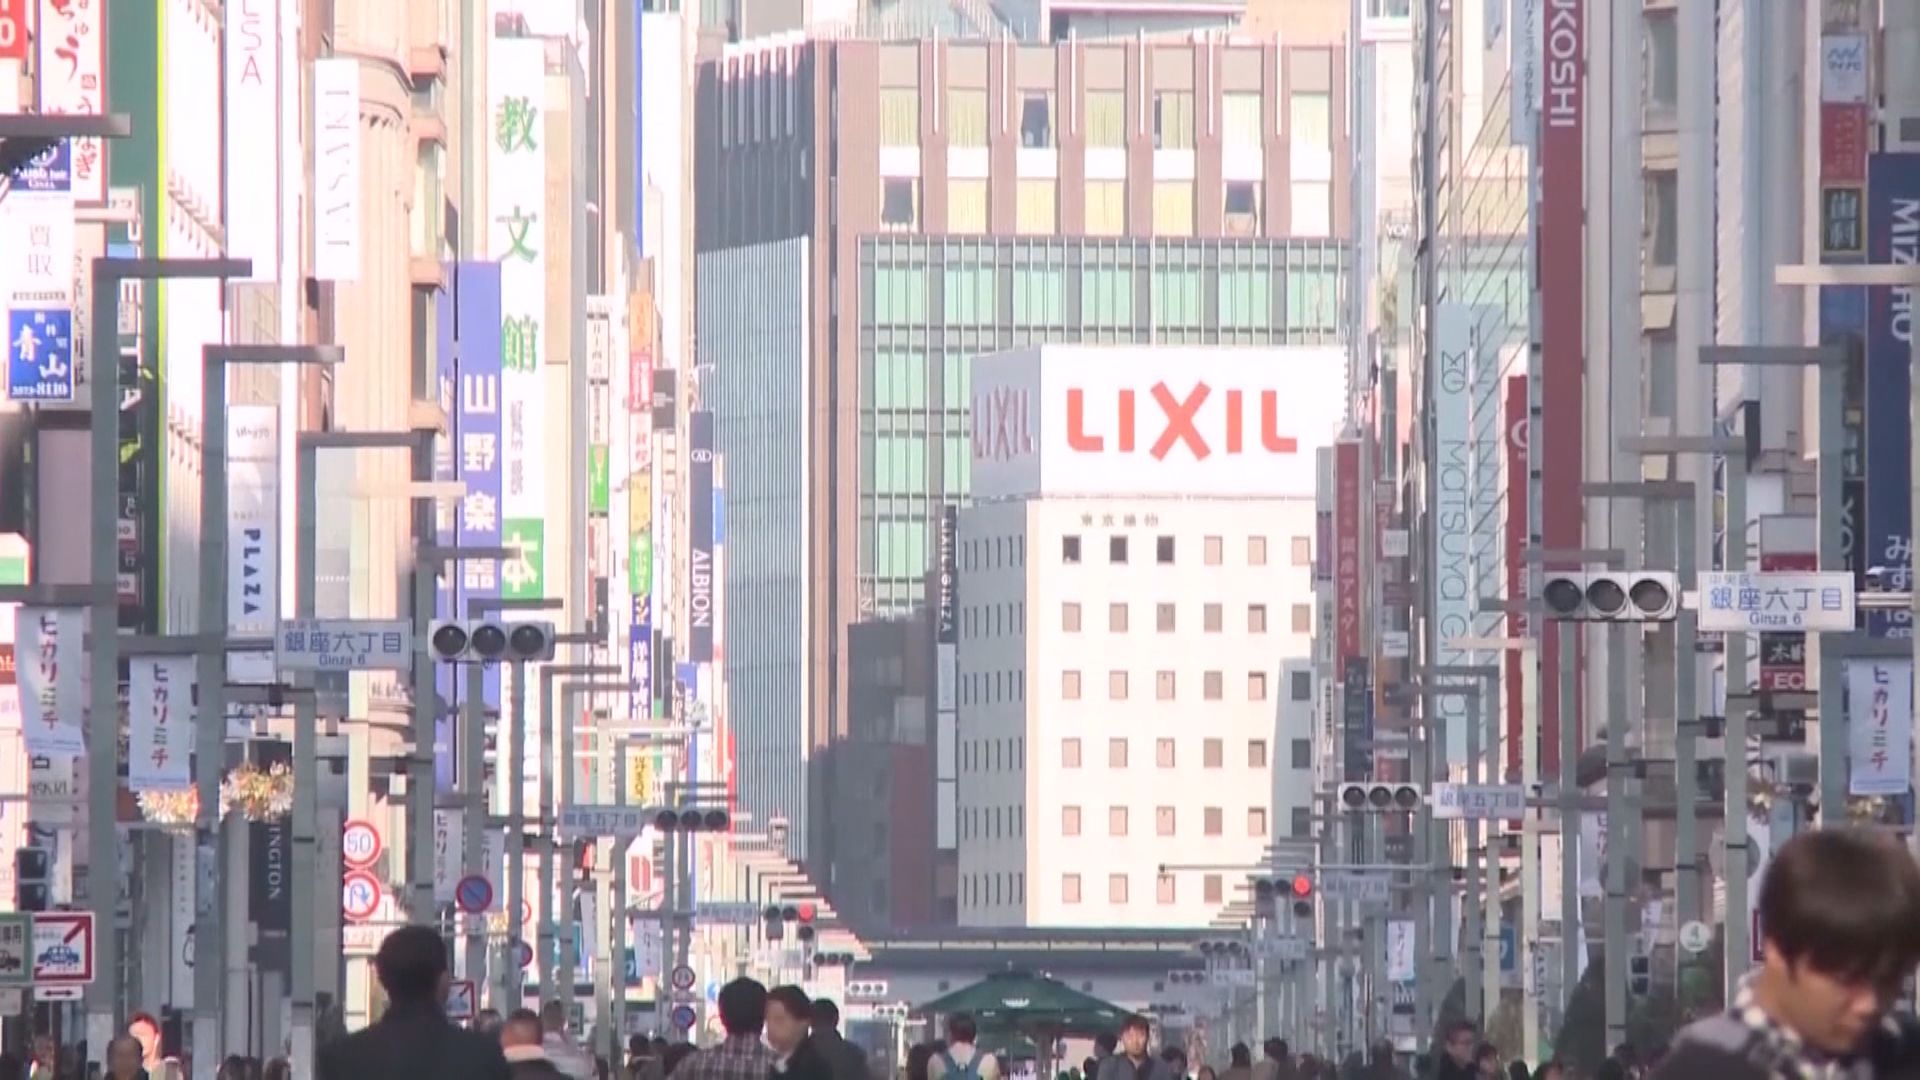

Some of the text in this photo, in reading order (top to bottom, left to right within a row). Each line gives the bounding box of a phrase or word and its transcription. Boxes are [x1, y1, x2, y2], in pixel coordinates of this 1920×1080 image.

[494, 96, 539, 373] 教文館
[1891, 198, 1919, 342] MIZHO
[972, 383, 1034, 462] LIXIL
[1067, 380, 1298, 462] LIXIL
[463, 373, 497, 589] 山野楽器
[243, 528, 261, 615] PLAZA
[502, 532, 538, 592] 本
[691, 548, 711, 627] ALBION
[1710, 586, 1842, 611] 銀座六丁目
[285, 631, 402, 654] 銀座六丁目
[318, 652, 366, 666] Ginza 6
[1749, 611, 1803, 626] Ginza 6
[40, 614, 59, 731] ヒカリミチ
[152, 662, 169, 769] ヒカリミチ
[1871, 664, 1889, 773] ヒカリミチ
